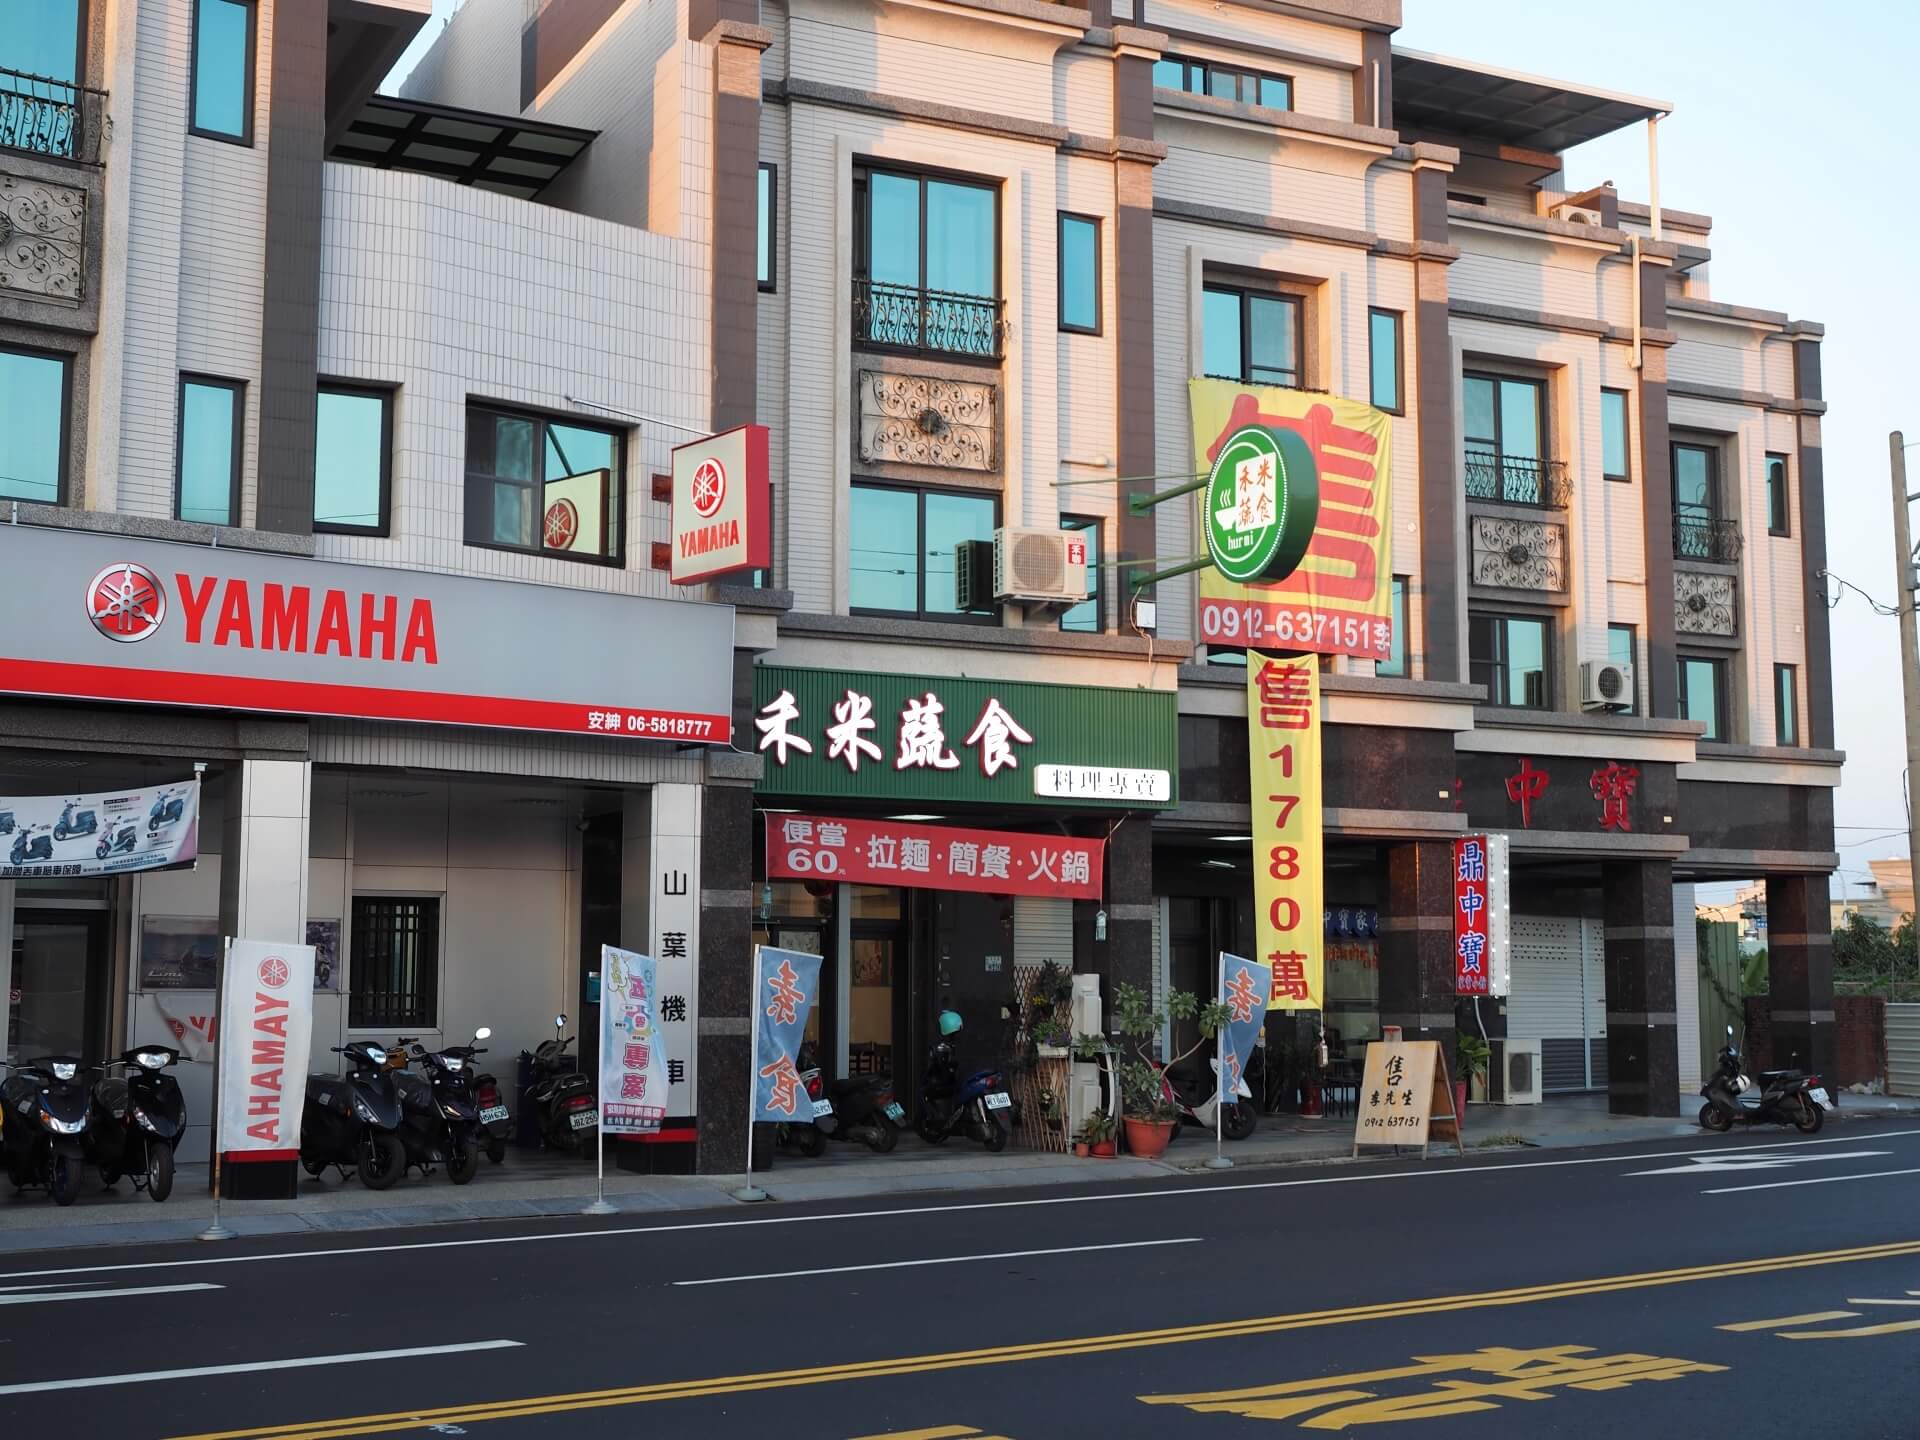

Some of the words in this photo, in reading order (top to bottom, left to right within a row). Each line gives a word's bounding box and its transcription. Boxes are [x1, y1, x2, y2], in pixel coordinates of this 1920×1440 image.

[679, 519, 740, 560] YAMAHA
[175, 573, 438, 665] YAMAHA
[1203, 605, 1370, 650] 0912-637151
[588, 711, 621, 731] 安紳
[627, 715, 712, 737] 06-5818777
[755, 689, 1034, 777] 禾米蔬食
[782, 818, 848, 848] 便當
[1254, 659, 1313, 1001] 售1780萬
[1457, 841, 1486, 974] 鼎中寶
[660, 869, 688, 1086] 山葉機車
[247, 991, 290, 1144] YAMAHA
[1369, 1089, 1413, 1107] 李先生
[1387, 1116, 1420, 1128] 637151
